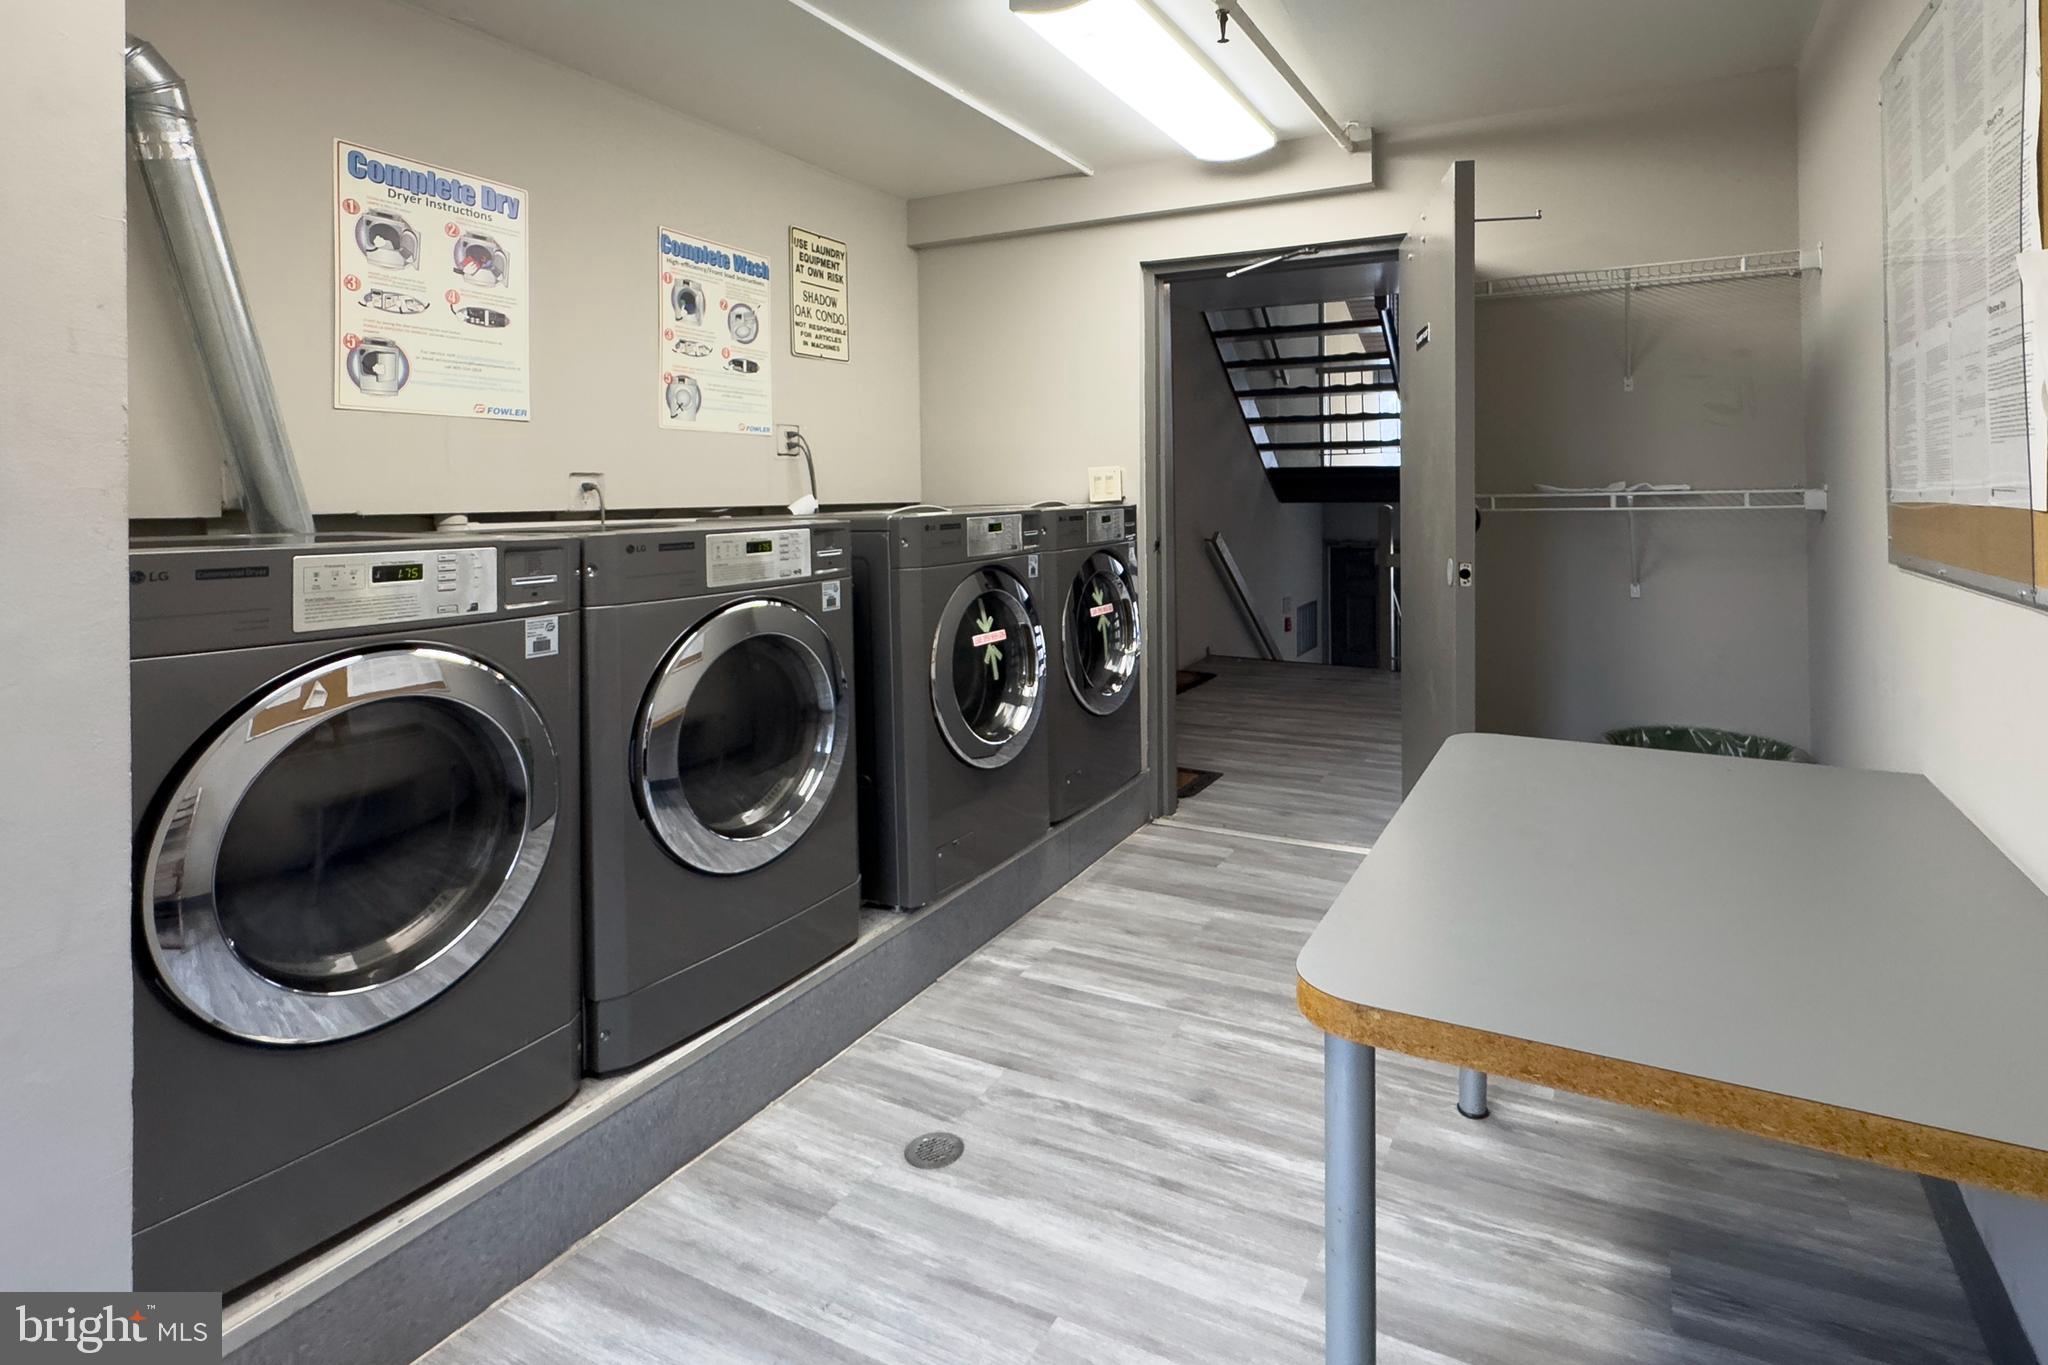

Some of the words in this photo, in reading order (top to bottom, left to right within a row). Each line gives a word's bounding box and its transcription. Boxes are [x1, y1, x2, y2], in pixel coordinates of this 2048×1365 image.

[347, 150, 476, 207] Complete
[481, 185, 520, 220] Dry
[387, 188, 422, 207] Dryer
[426, 197, 493, 222] Instructions
[660, 233, 731, 270] Complete
[733, 253, 770, 281] Wash
[794, 237, 808, 250] USE
[811, 242, 845, 261] LAUNDRY
[799, 252, 841, 272] EQUIPMENT
[795, 264, 804, 274] AT
[807, 267, 825, 280] OWN
[827, 272, 844, 285] RISK
[802, 290, 838, 309] SHADOW
[795, 304, 812, 319] OAK
[815, 308, 847, 327] CONDO.
[795, 321, 807, 329] NOT
[808, 323, 847, 337] RESPONSIBLE
[800, 330, 812, 339] FOR
[815, 333, 842, 344] ARTICLES
[811, 342, 841, 353] MACHINES
[487, 407, 527, 417] FOWLER
[746, 424, 770, 433] FOWLER
[635, 544, 647, 553] LG
[148, 571, 169, 582] LG
